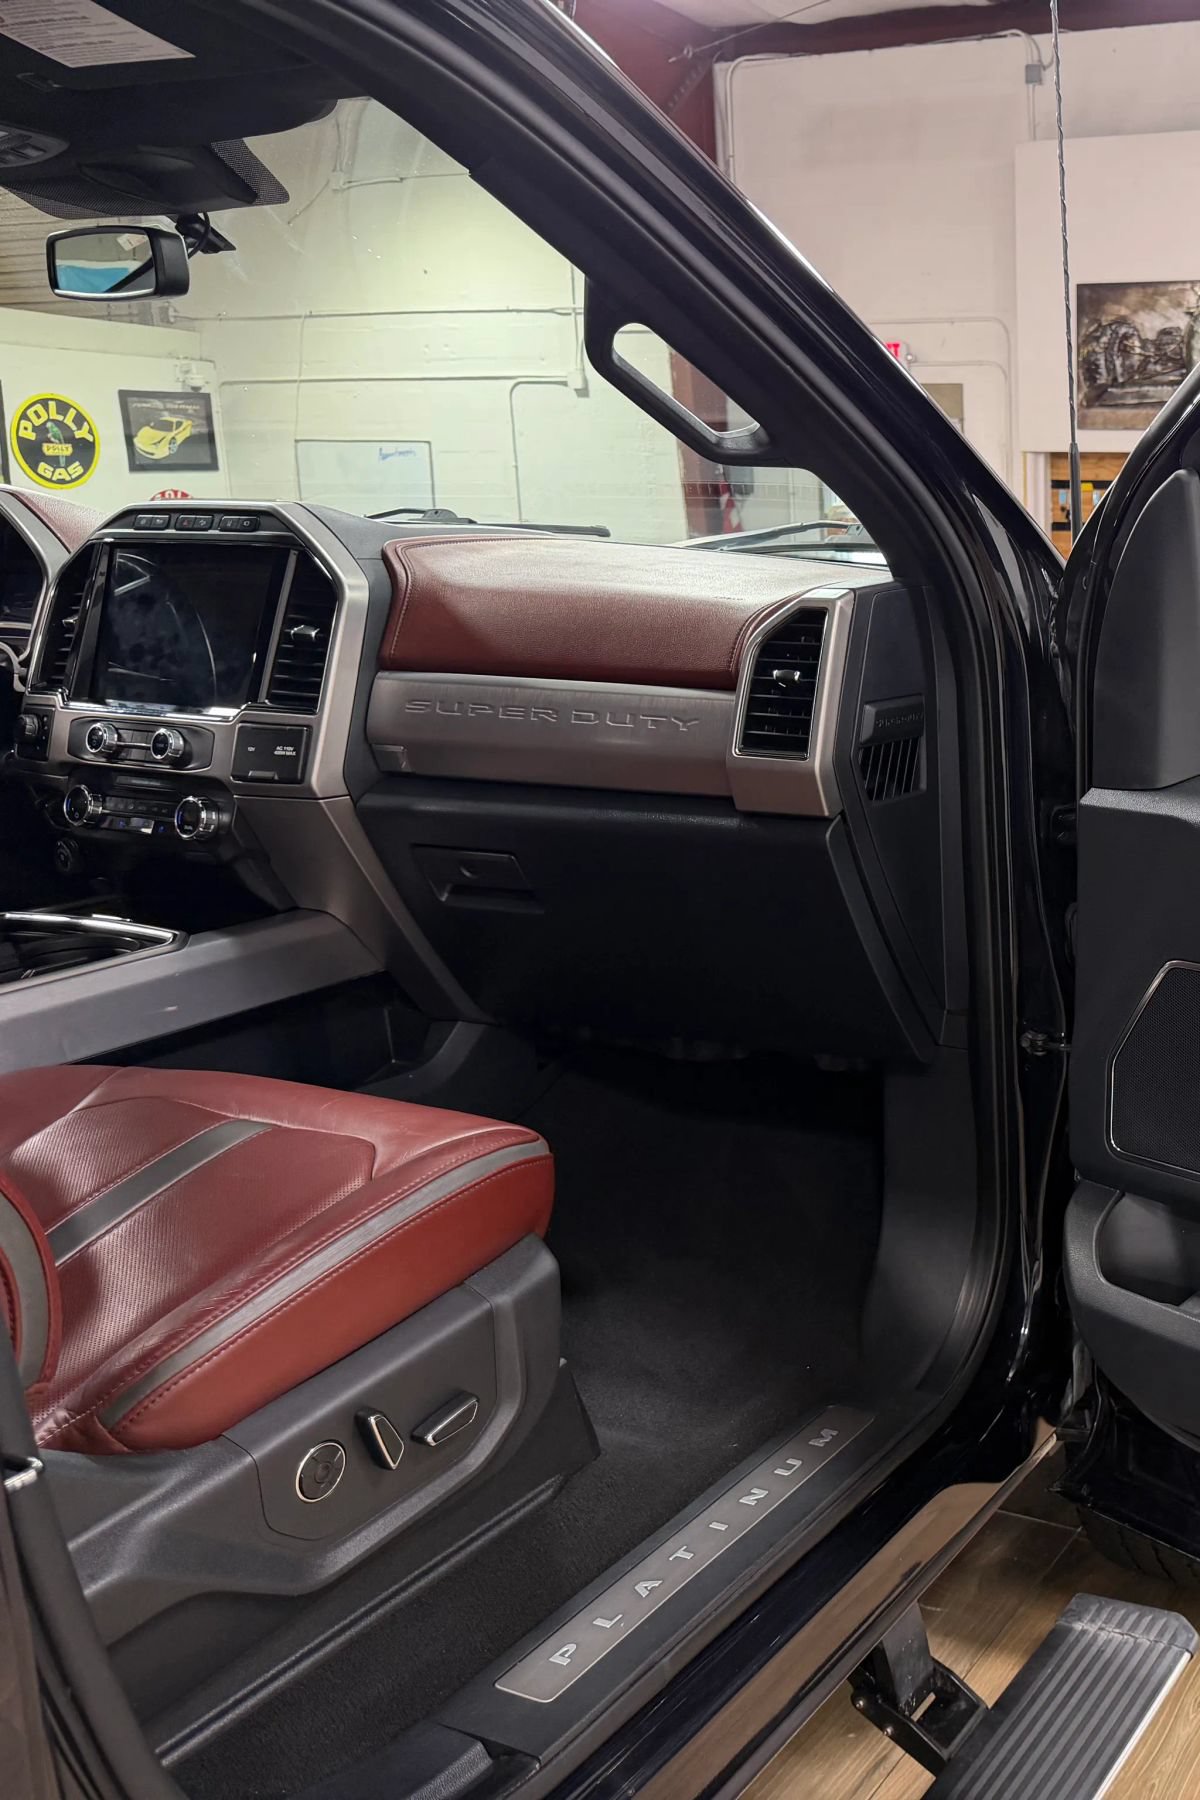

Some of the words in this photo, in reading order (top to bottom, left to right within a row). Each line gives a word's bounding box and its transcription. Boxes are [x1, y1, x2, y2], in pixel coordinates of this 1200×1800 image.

[18, 400, 94, 442] POLLY
[37, 461, 84, 481] GAS
[404, 699, 558, 723] SUPER
[570, 709, 701, 732] DUTY
[549, 1428, 838, 1665] PLATINUM
